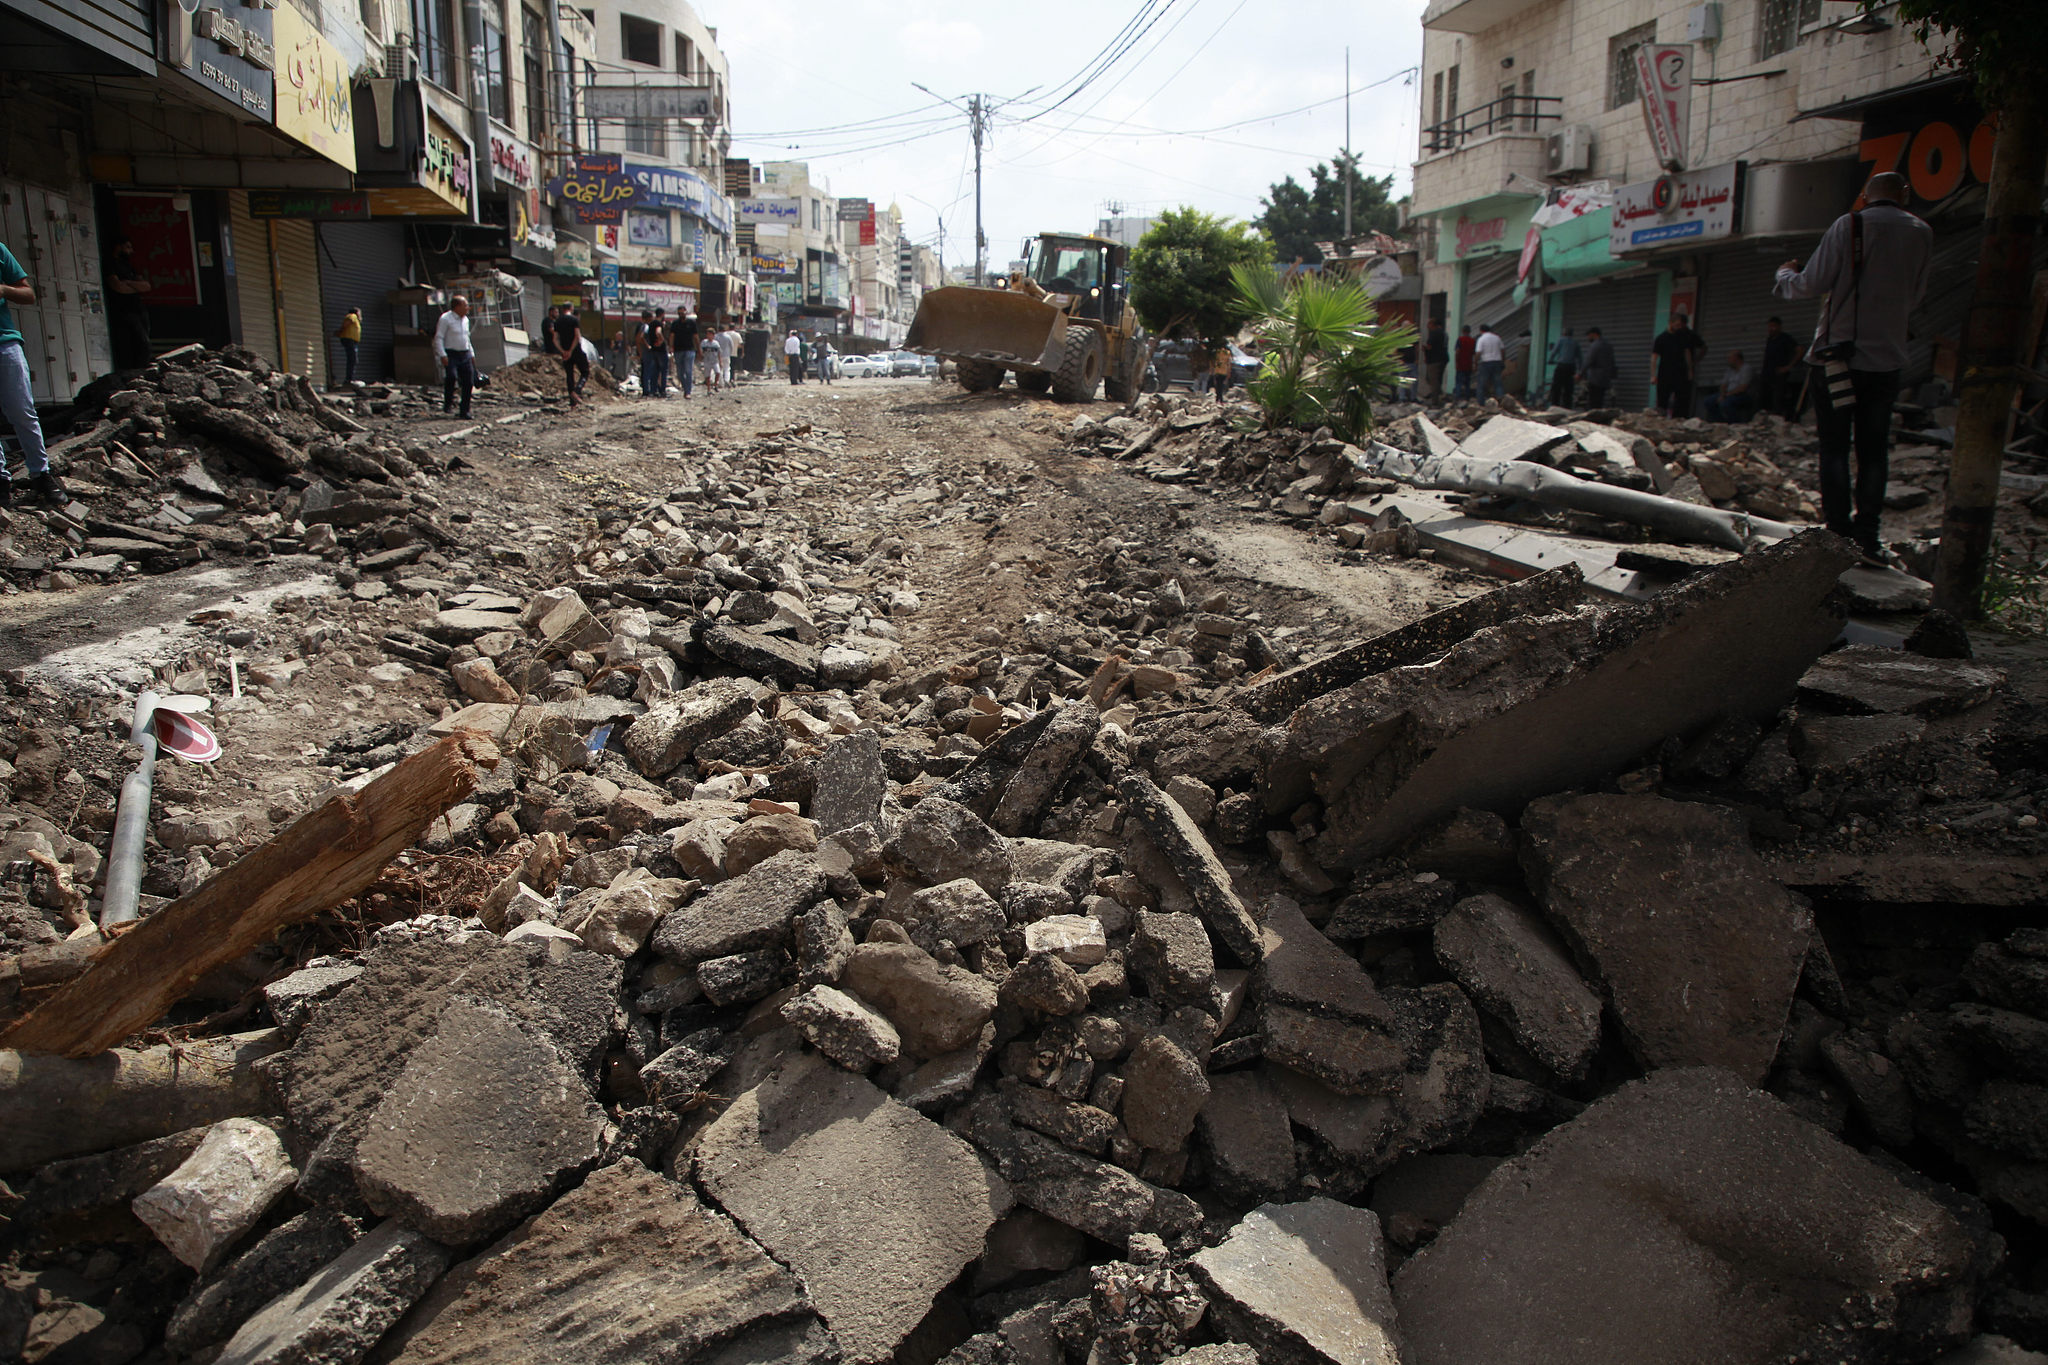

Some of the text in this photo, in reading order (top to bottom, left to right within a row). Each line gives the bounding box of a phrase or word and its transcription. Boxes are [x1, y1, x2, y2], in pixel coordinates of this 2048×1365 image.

[577, 155, 620, 176] مؤسسة
[740, 200, 766, 215] تفاحة
[1680, 183, 1730, 216] صيدلية
[576, 205, 621, 222] التجارية
[768, 203, 798, 219] بصريات
[1613, 194, 1657, 228] لسطين
